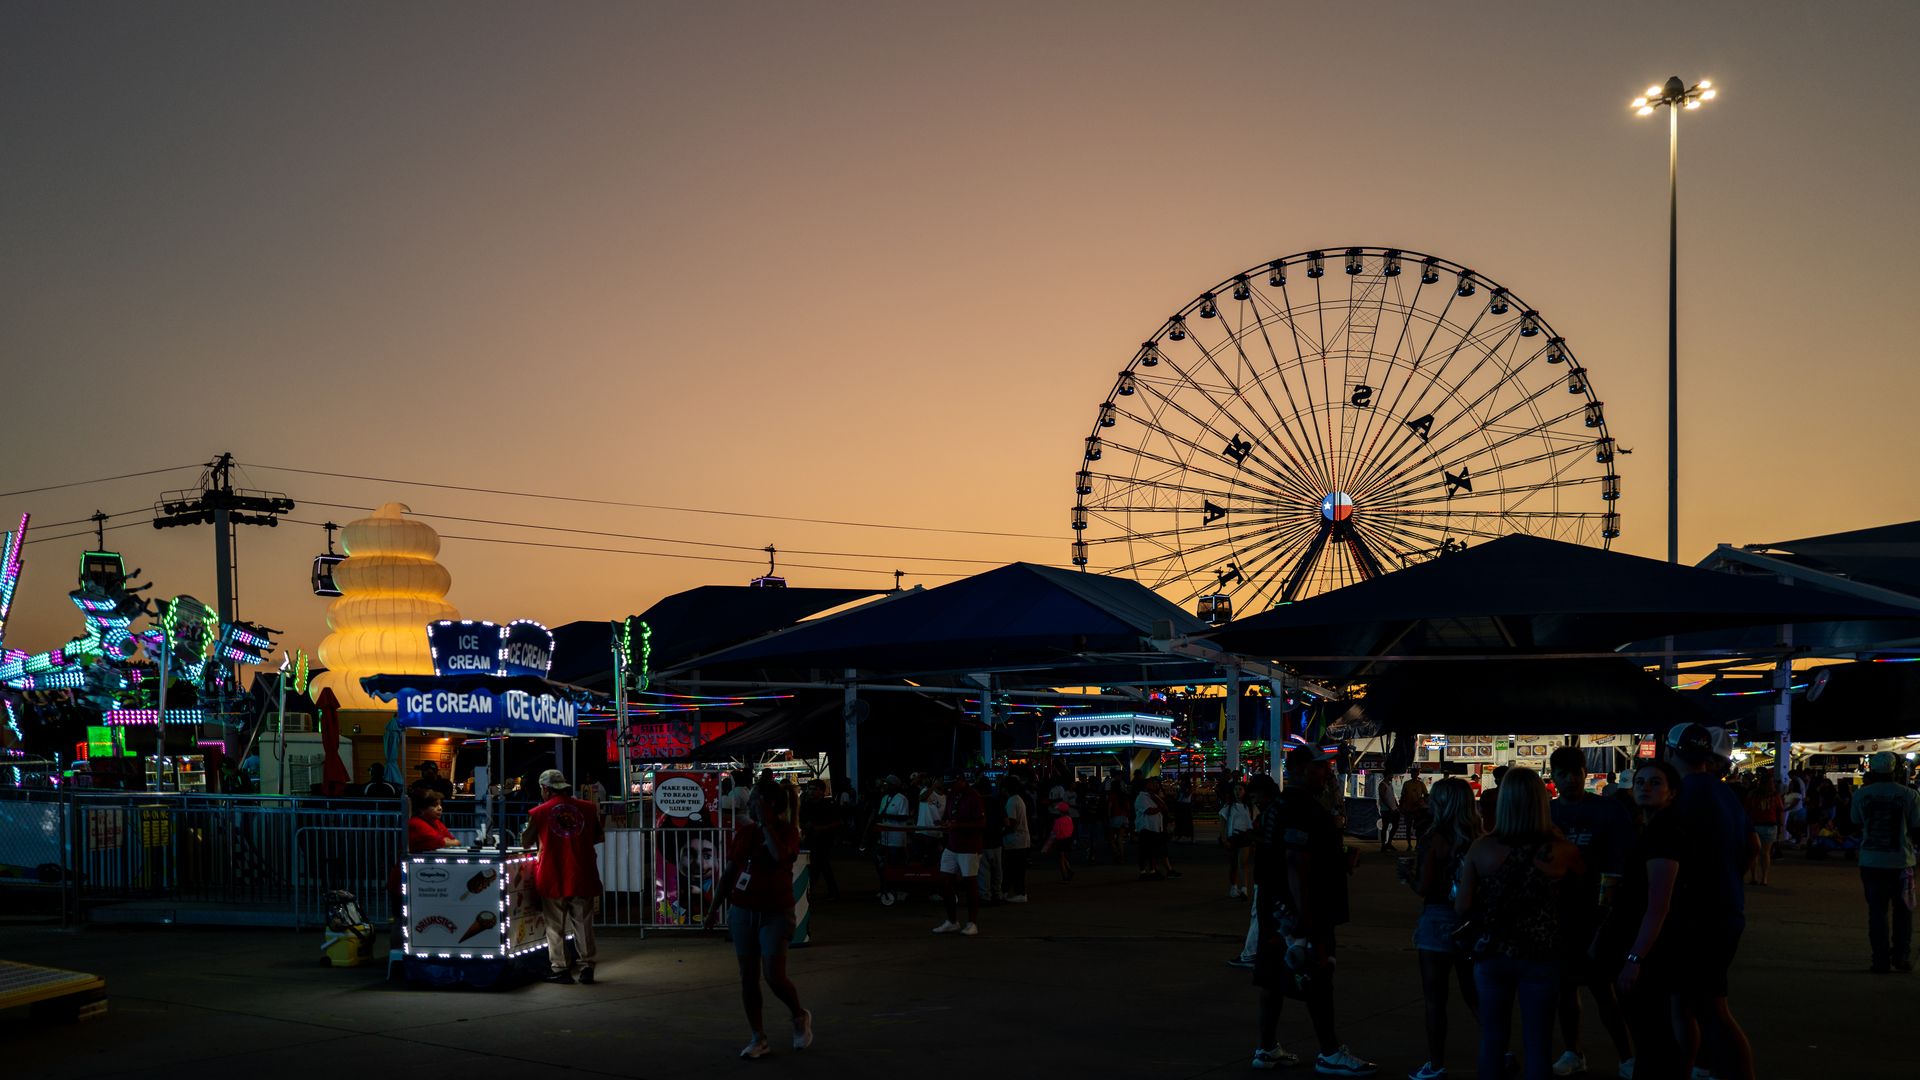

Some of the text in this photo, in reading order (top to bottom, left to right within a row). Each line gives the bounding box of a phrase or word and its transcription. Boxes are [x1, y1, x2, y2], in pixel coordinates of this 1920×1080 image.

[459, 635, 479, 650] ICE
[448, 655, 490, 669] CREAM
[521, 643, 548, 671] CREAM
[407, 693, 492, 713] ICE CREAM
[506, 692, 574, 727] ICE CREAM
[1059, 724, 1170, 738] COUPONS COUPONS
[415, 916, 458, 934] DRUMSTICK
